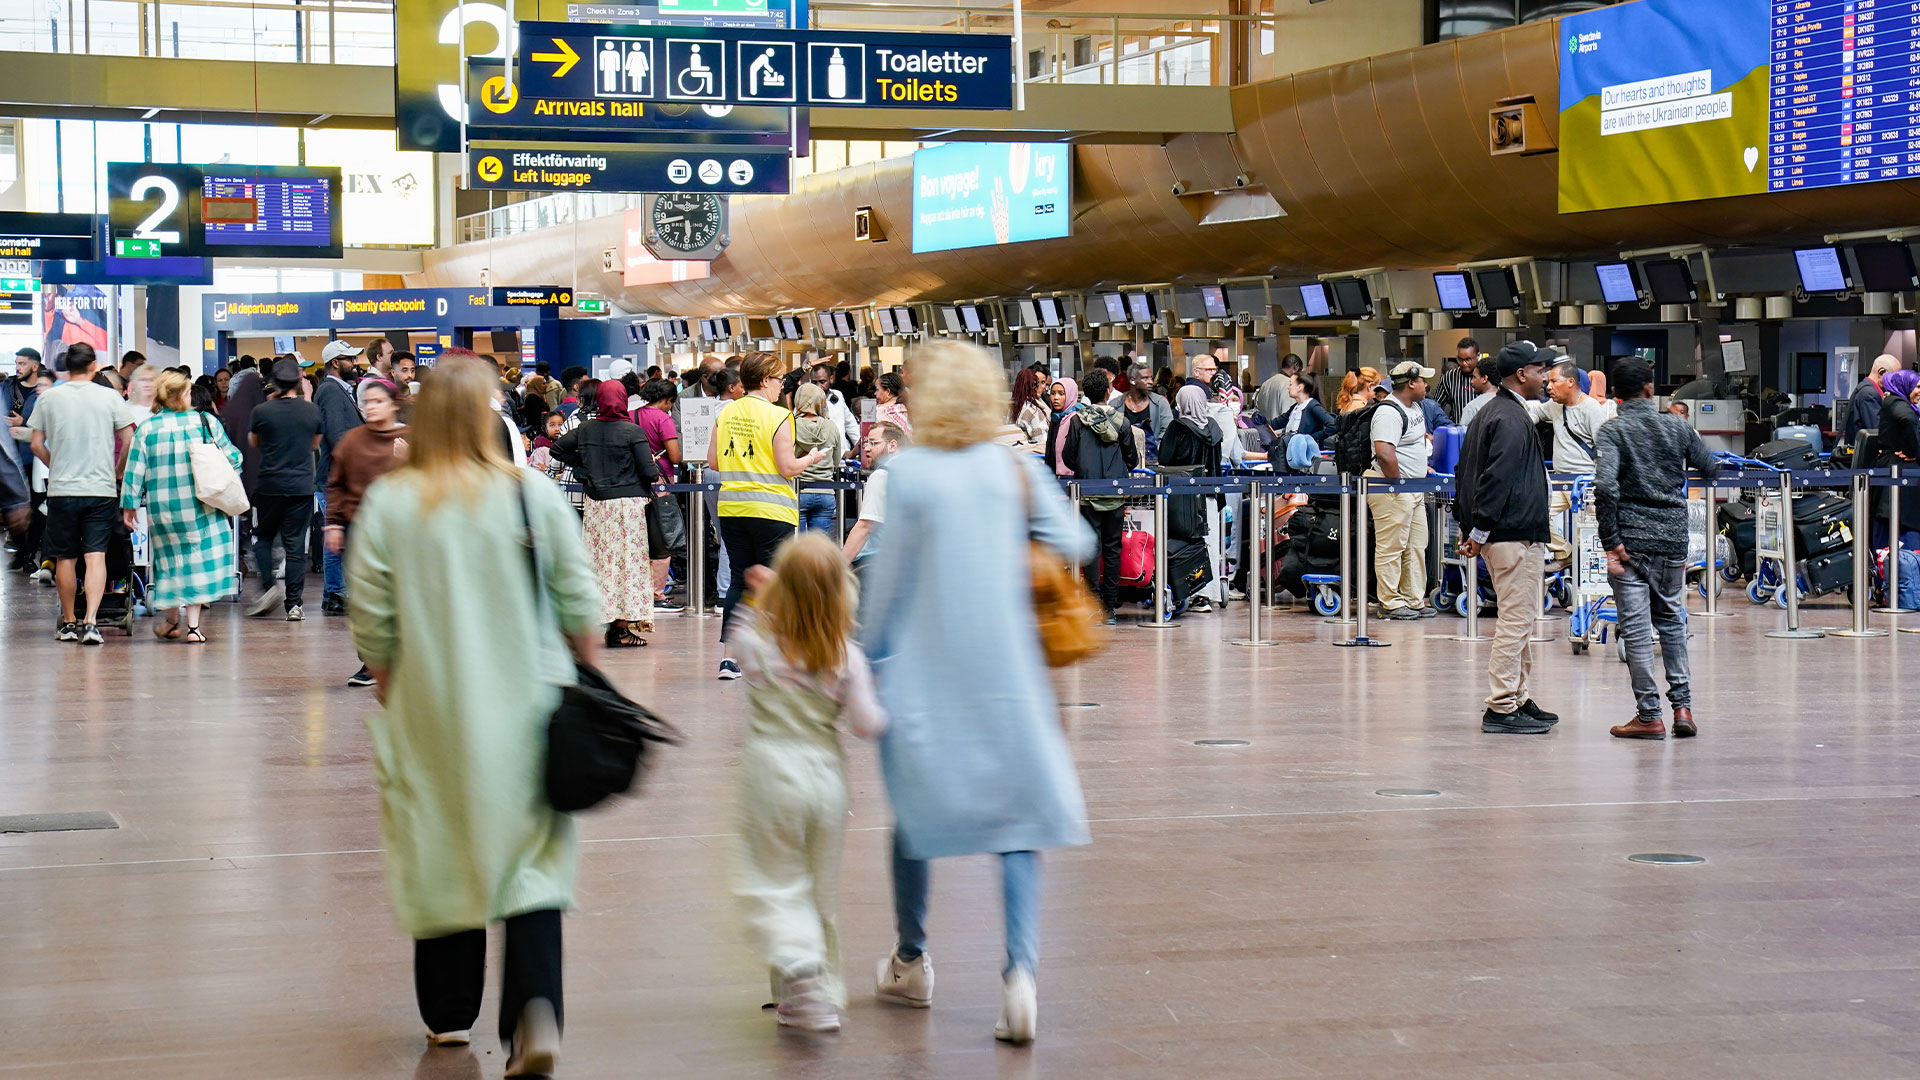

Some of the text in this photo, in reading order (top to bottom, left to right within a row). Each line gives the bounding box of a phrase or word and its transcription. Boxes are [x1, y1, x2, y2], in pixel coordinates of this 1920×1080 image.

[1578, 30, 1602, 44] Swedavia
[1578, 42, 1598, 54] Airports
[876, 49, 988, 74] Toaletter
[876, 78, 959, 102] Toilets
[1604, 76, 1706, 106] Our hearts and thoughts
[534, 100, 644, 117] Arrivals hall
[1604, 96, 1730, 130] are with the Ukrainian people.
[512, 152, 607, 171] Effektförvaring
[1035, 151, 1056, 182] kry
[342, 174, 383, 194] EX
[513, 169, 592, 186] Left luggage
[920, 164, 980, 200] Bon voyage!
[130, 175, 180, 244] 2
[664, 200, 673, 210] 10
[703, 202, 710, 210] 2
[706, 213, 713, 222] 3
[664, 224, 671, 233] 8
[702, 224, 710, 233] 4
[674, 232, 680, 241] 7
[684, 235, 690, 244] 6
[695, 232, 702, 241] 5
[15, 248, 32, 256] hall
[55, 296, 72, 310] HERE
[73, 296, 90, 310] FOR
[469, 294, 486, 306] Fast
[550, 292, 558, 304] A
[228, 302, 298, 316] All departure gates
[345, 298, 448, 316] Security checkpoint D
[1239, 313, 1249, 325] 20B
